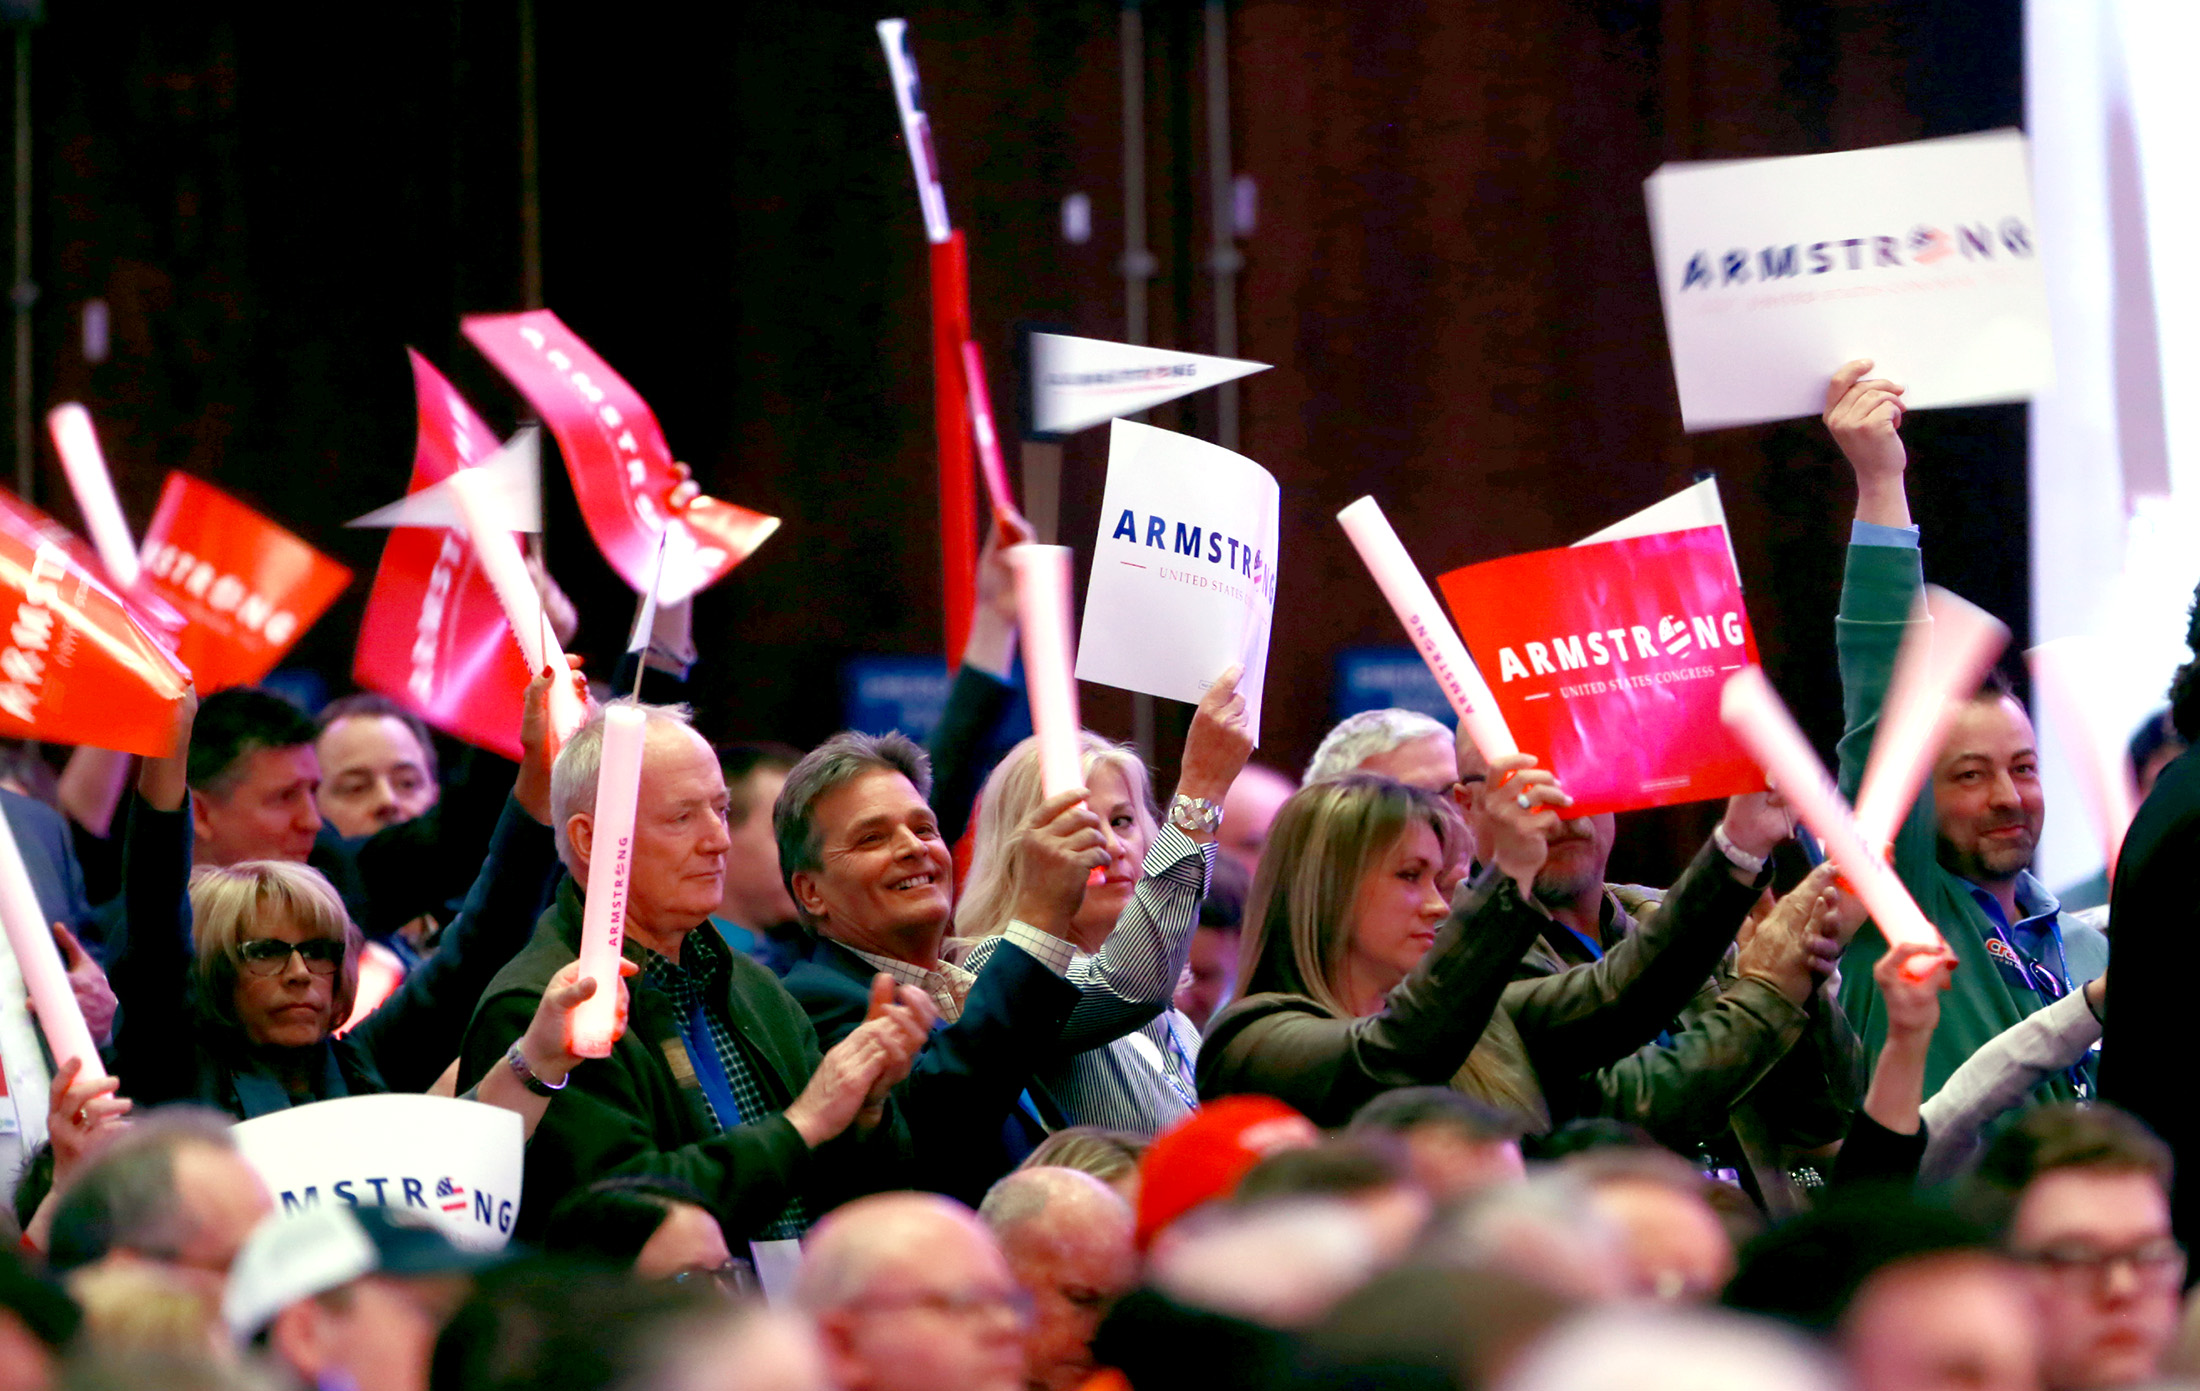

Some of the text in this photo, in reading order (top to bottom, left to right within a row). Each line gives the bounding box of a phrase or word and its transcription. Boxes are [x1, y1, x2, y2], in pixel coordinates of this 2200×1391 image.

[1680, 215, 2034, 292] ARMSTRONG
[1112, 509, 1275, 606] ARMSTRONG
[1159, 566, 1244, 602] UNITED STATES
[1410, 614, 1475, 714] ARMSTRONG
[1499, 611, 1745, 683] ARMSTRONG
[1559, 665, 1716, 699] UNITED STATES CONGRESS
[608, 837, 628, 947] ARMSTRONG
[280, 1176, 512, 1235] MSTRONG
